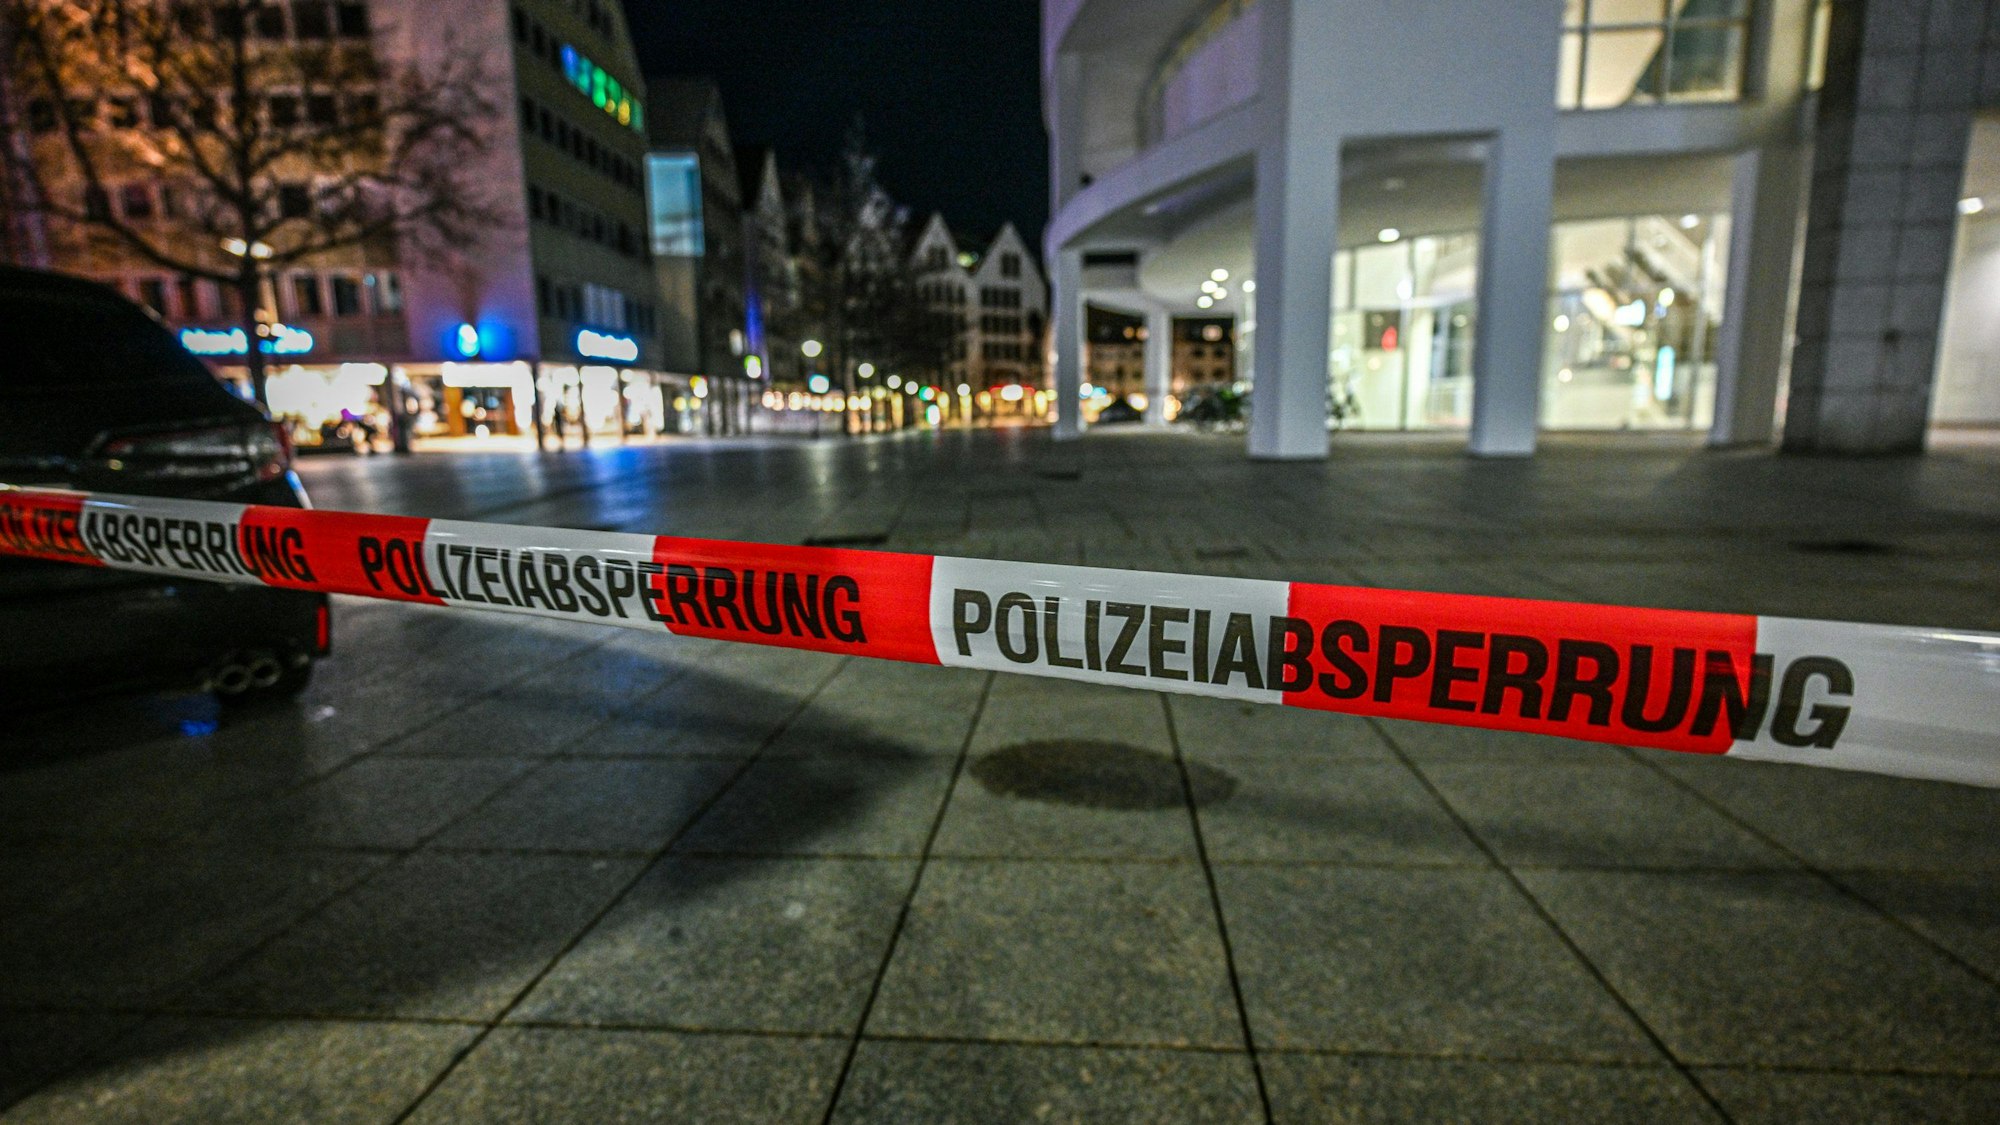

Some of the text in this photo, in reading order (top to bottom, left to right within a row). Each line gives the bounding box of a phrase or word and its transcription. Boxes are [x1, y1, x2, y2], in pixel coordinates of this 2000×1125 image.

[0, 503, 317, 583] OLIZEIABSPERRUNG
[359, 536, 868, 644] POLIZEIABSPERRUNG
[952, 588, 1855, 750] POLIZEIABSPERRUNG
